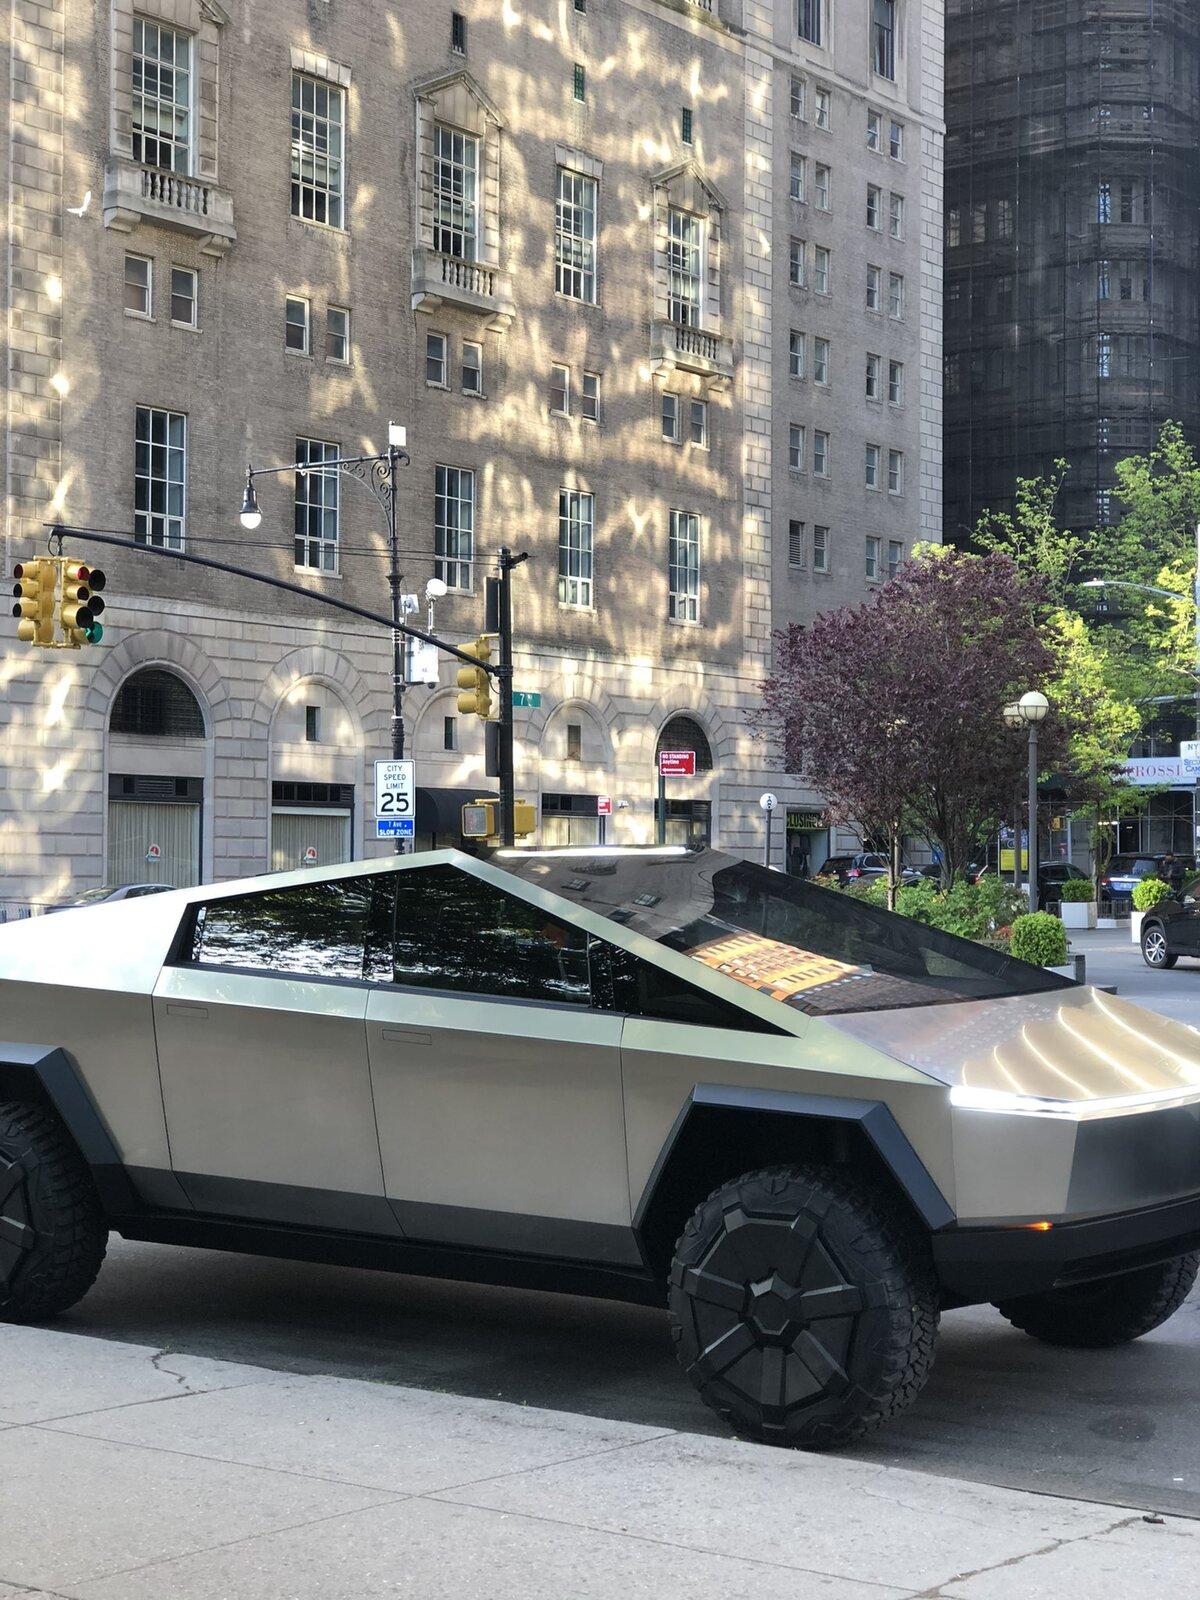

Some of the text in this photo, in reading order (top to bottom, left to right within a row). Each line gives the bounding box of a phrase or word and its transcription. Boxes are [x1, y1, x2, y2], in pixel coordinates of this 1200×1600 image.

[383, 773, 407, 781] SPEED
[386, 782, 404, 790] LIMIT
[381, 792, 410, 812] 25
